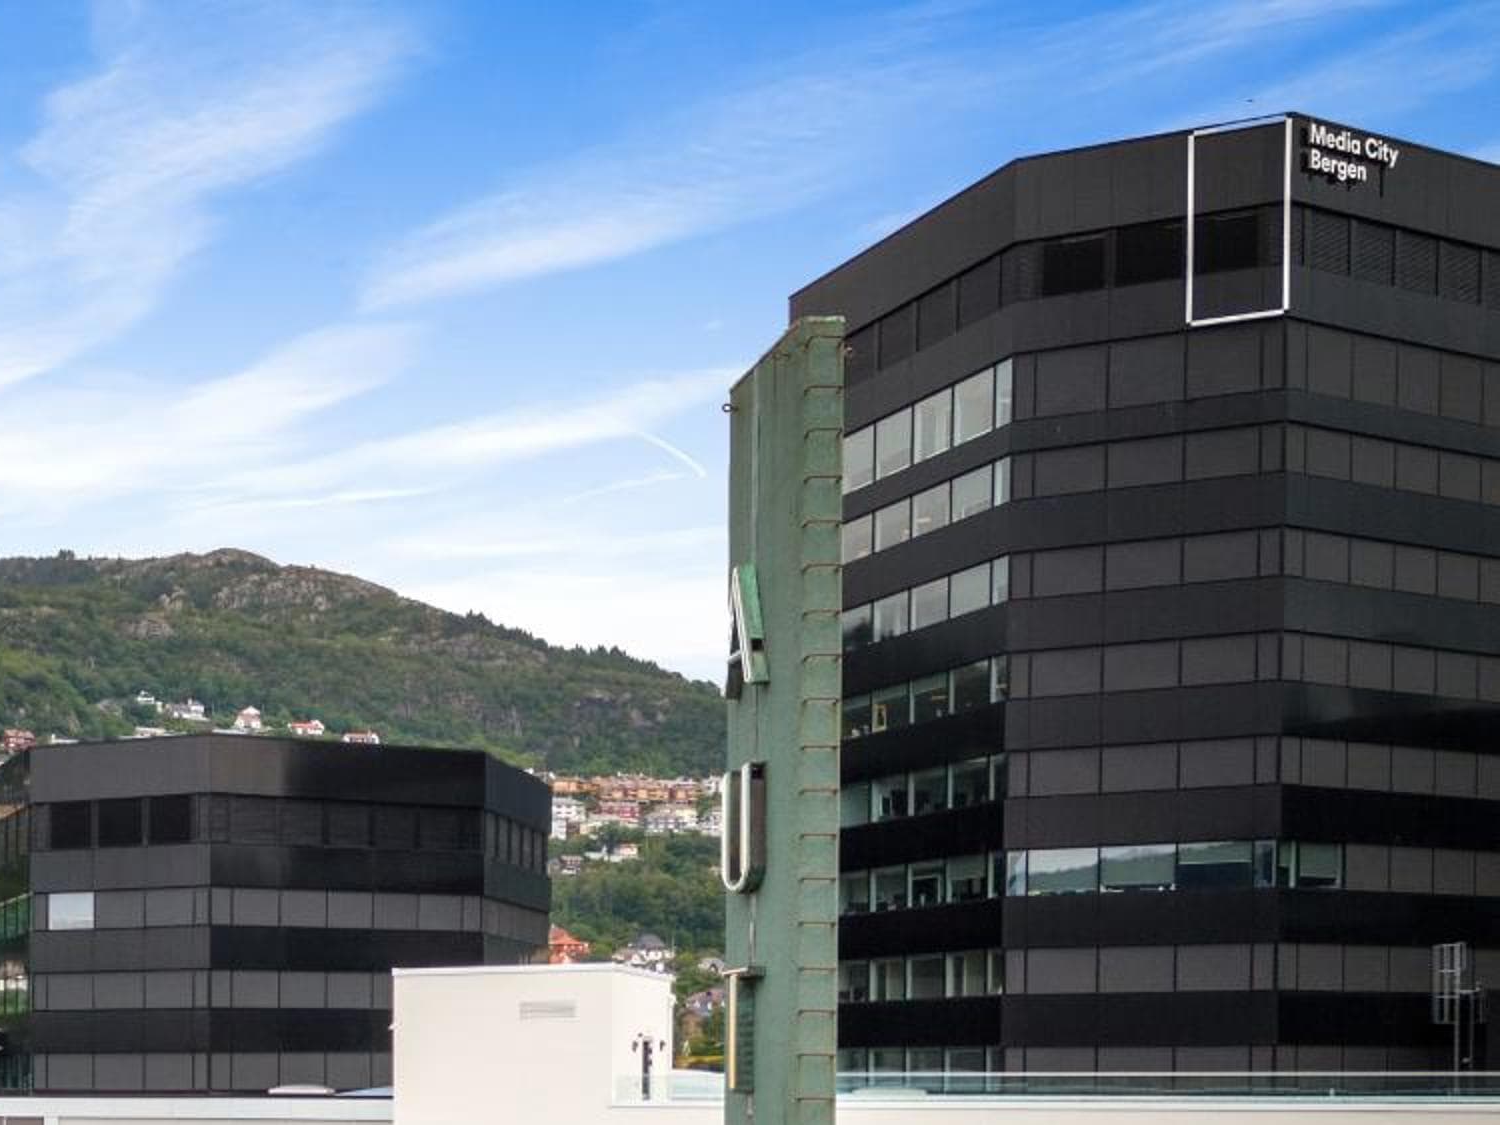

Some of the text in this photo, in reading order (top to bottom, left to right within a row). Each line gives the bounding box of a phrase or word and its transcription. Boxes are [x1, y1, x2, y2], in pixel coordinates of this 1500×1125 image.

[1310, 123, 1399, 168] Media City
[1310, 149, 1367, 181] Bergen
